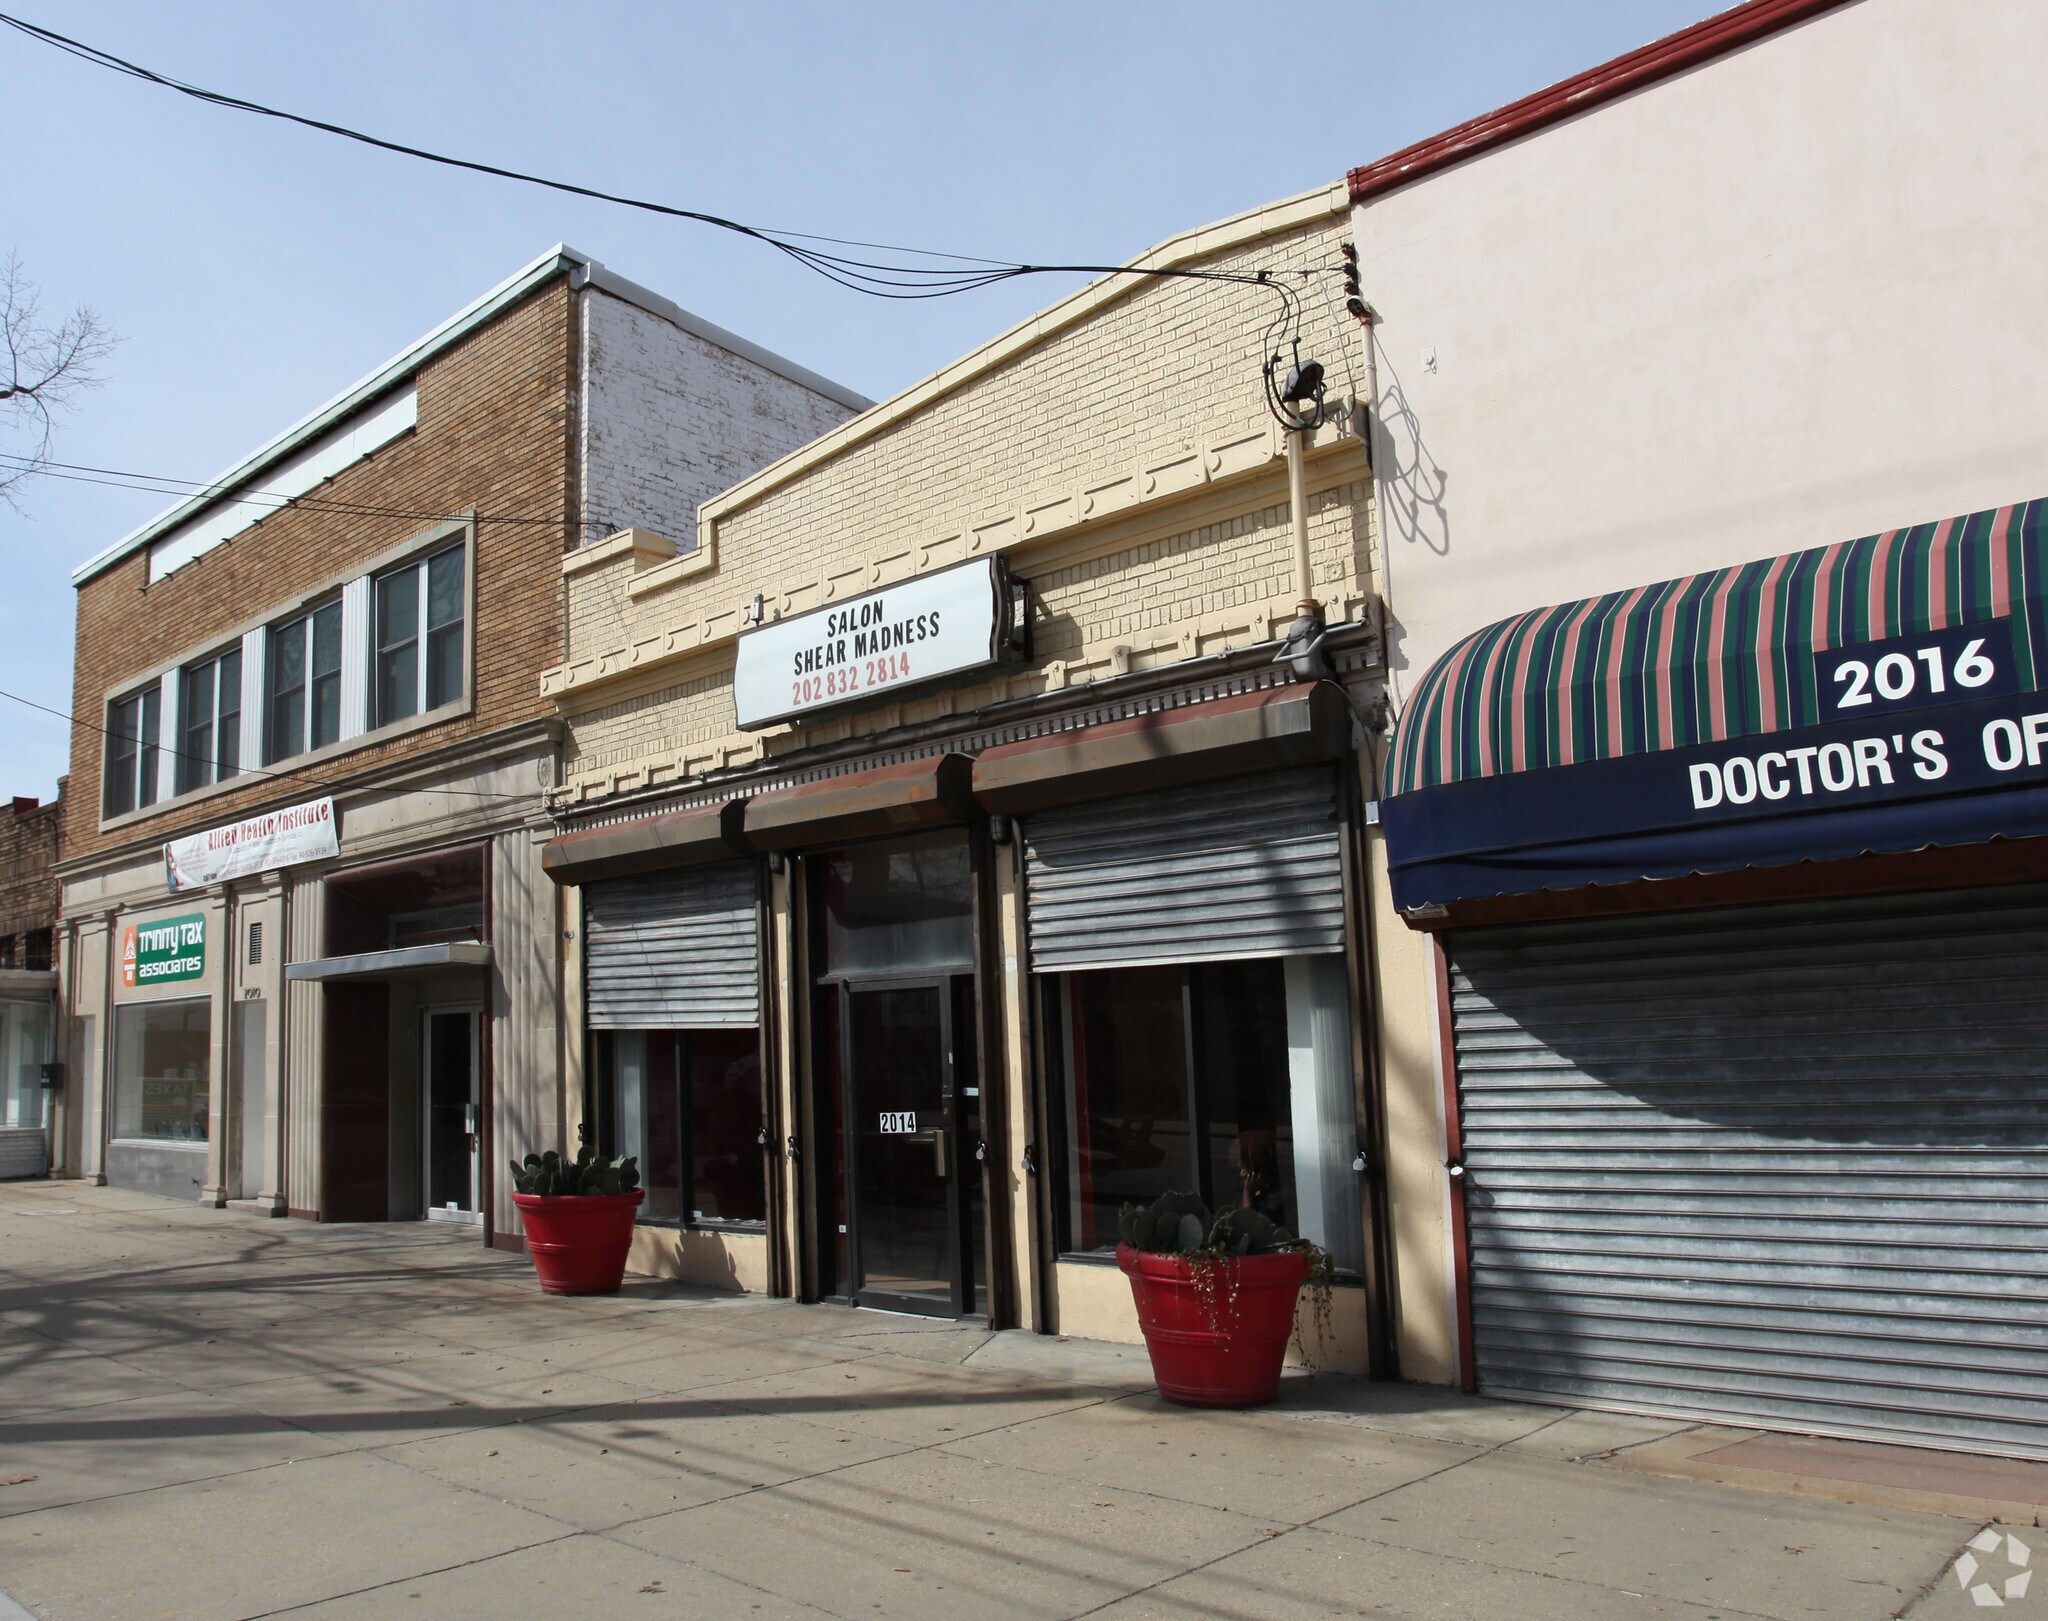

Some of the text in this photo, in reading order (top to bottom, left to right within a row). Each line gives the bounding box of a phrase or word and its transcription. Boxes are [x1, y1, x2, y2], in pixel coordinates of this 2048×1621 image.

[794, 611, 940, 676] SHEAR MADNESS
[828, 600, 883, 637] SALON
[793, 651, 910, 705] 202 832 2814
[1833, 638, 1995, 709] 2016
[1688, 729, 1948, 810] DOCTOR'S
[209, 826, 237, 851] Allied
[241, 815, 274, 842] Health
[279, 803, 329, 832] Institute
[881, 1113, 915, 1132] 2014
